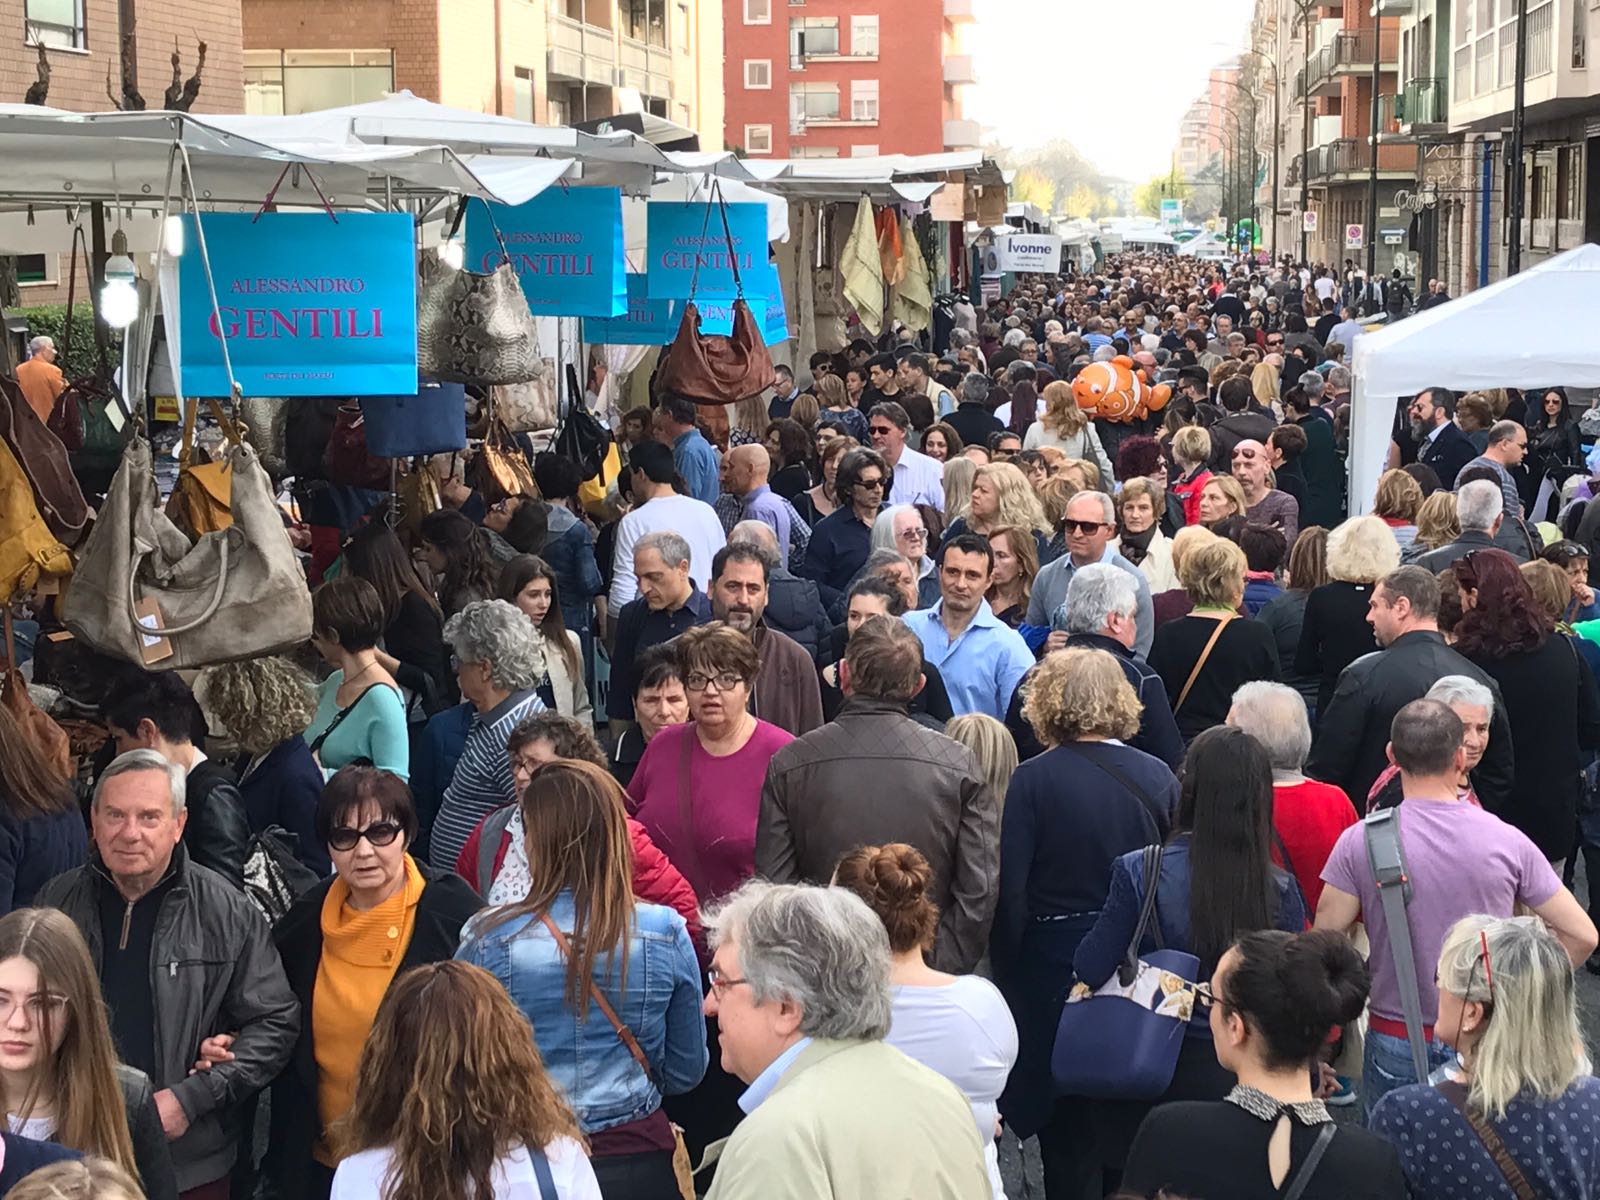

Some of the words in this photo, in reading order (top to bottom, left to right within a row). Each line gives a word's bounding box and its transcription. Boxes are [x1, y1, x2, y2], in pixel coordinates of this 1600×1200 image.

[1424, 143, 1494, 158] VOLLY
[501, 231, 583, 244] LESSANDRO
[673, 235, 743, 246] ALESSANDO
[1007, 237, 1052, 255] Ivonne
[230, 277, 366, 295] ALESSANDRO
[697, 302, 735, 322] GENT
[207, 306, 385, 340] GENTILI
